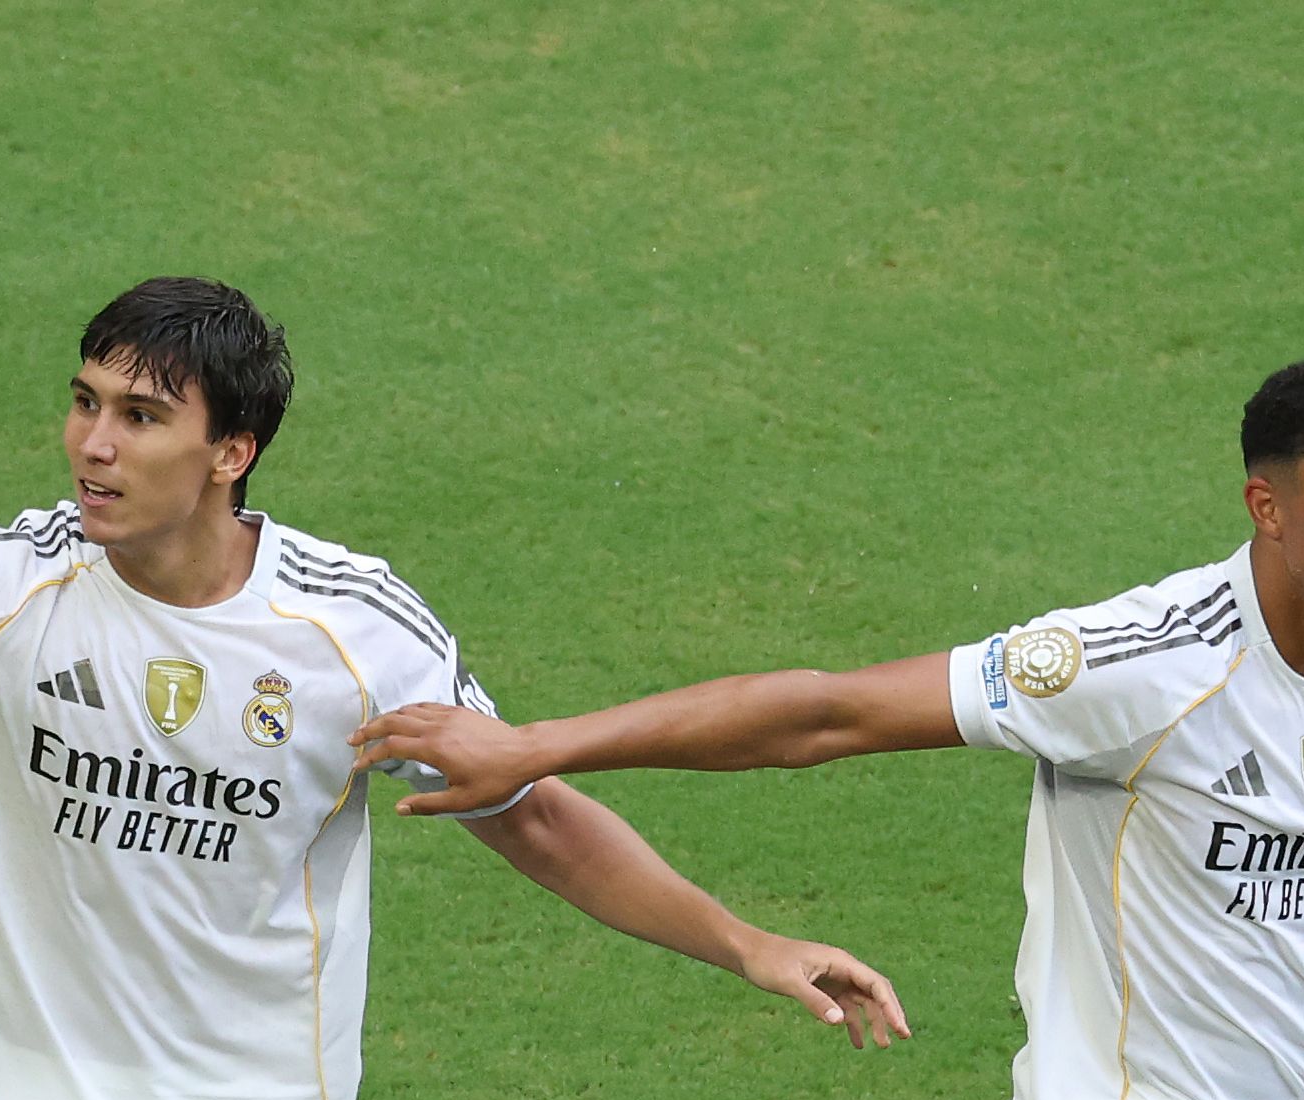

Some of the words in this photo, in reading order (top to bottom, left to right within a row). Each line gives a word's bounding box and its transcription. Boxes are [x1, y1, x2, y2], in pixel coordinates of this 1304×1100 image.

[1019, 631, 1046, 645] CLUB
[1048, 632, 1073, 656] WORLD
[1008, 647, 1021, 677] FIFA
[1060, 658, 1073, 679] CUP
[1024, 677, 1045, 691] USA
[1046, 677, 1060, 688] 25
[29, 724, 282, 819] Emirates
[53, 797, 112, 844] FLY
[117, 810, 238, 863] BETTER
[1225, 880, 1273, 922] FLY
